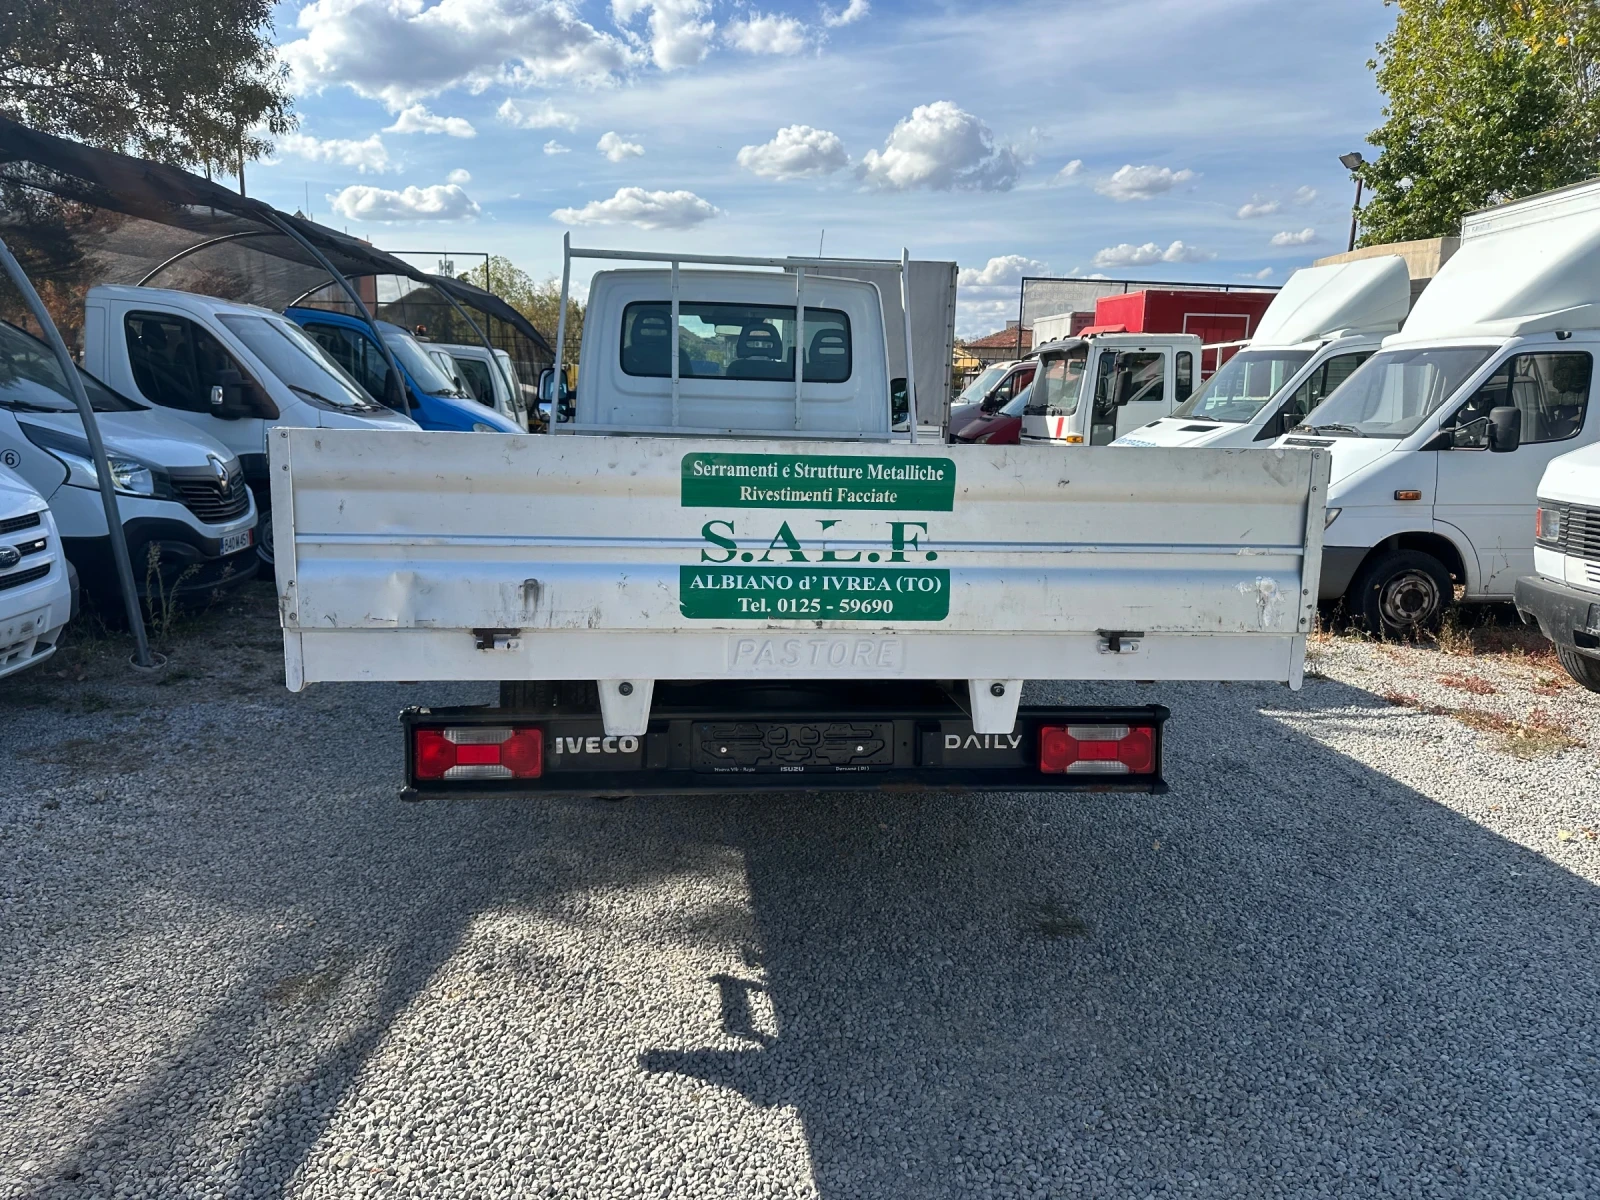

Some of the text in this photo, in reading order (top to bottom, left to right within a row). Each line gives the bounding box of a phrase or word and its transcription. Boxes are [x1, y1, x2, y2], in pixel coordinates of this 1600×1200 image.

[4, 452, 16, 466] 6
[693, 460, 944, 481] Serramenti e Strutture Metalliche
[739, 485, 898, 503] Rivestimenti Facciate
[689, 574, 793, 590] ALBIANO
[823, 576, 891, 592] IVREA
[896, 576, 942, 594] (TO)
[738, 597, 771, 613] Tel.
[777, 598, 821, 613] 0125
[839, 598, 894, 614] 59690
[733, 638, 899, 668] PASTORE
[555, 736, 639, 754] IVECO
[944, 734, 1023, 749] DAILY
